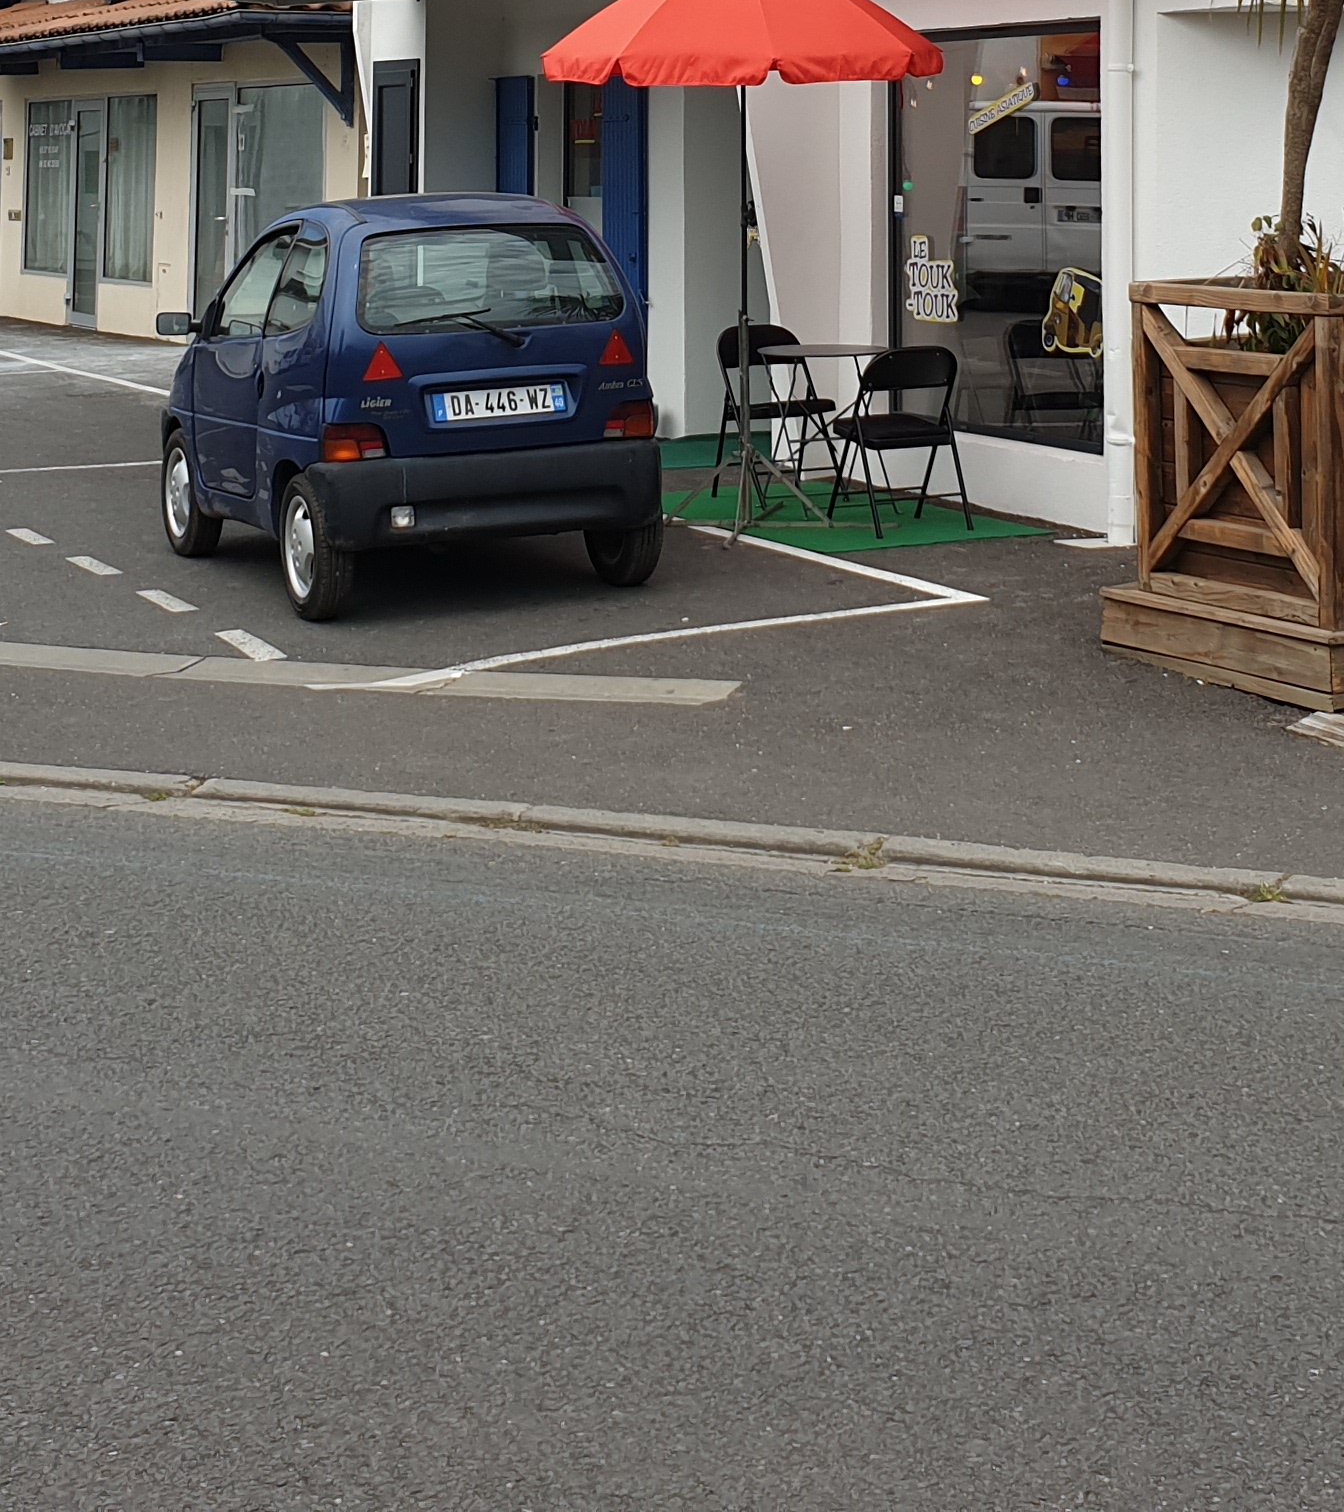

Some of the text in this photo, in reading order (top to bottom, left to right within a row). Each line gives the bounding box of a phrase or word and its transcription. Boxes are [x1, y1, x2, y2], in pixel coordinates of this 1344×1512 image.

[913, 240, 927, 259] LE
[909, 262, 951, 289] TOUK
[450, 388, 551, 417] DA-446-WZ
